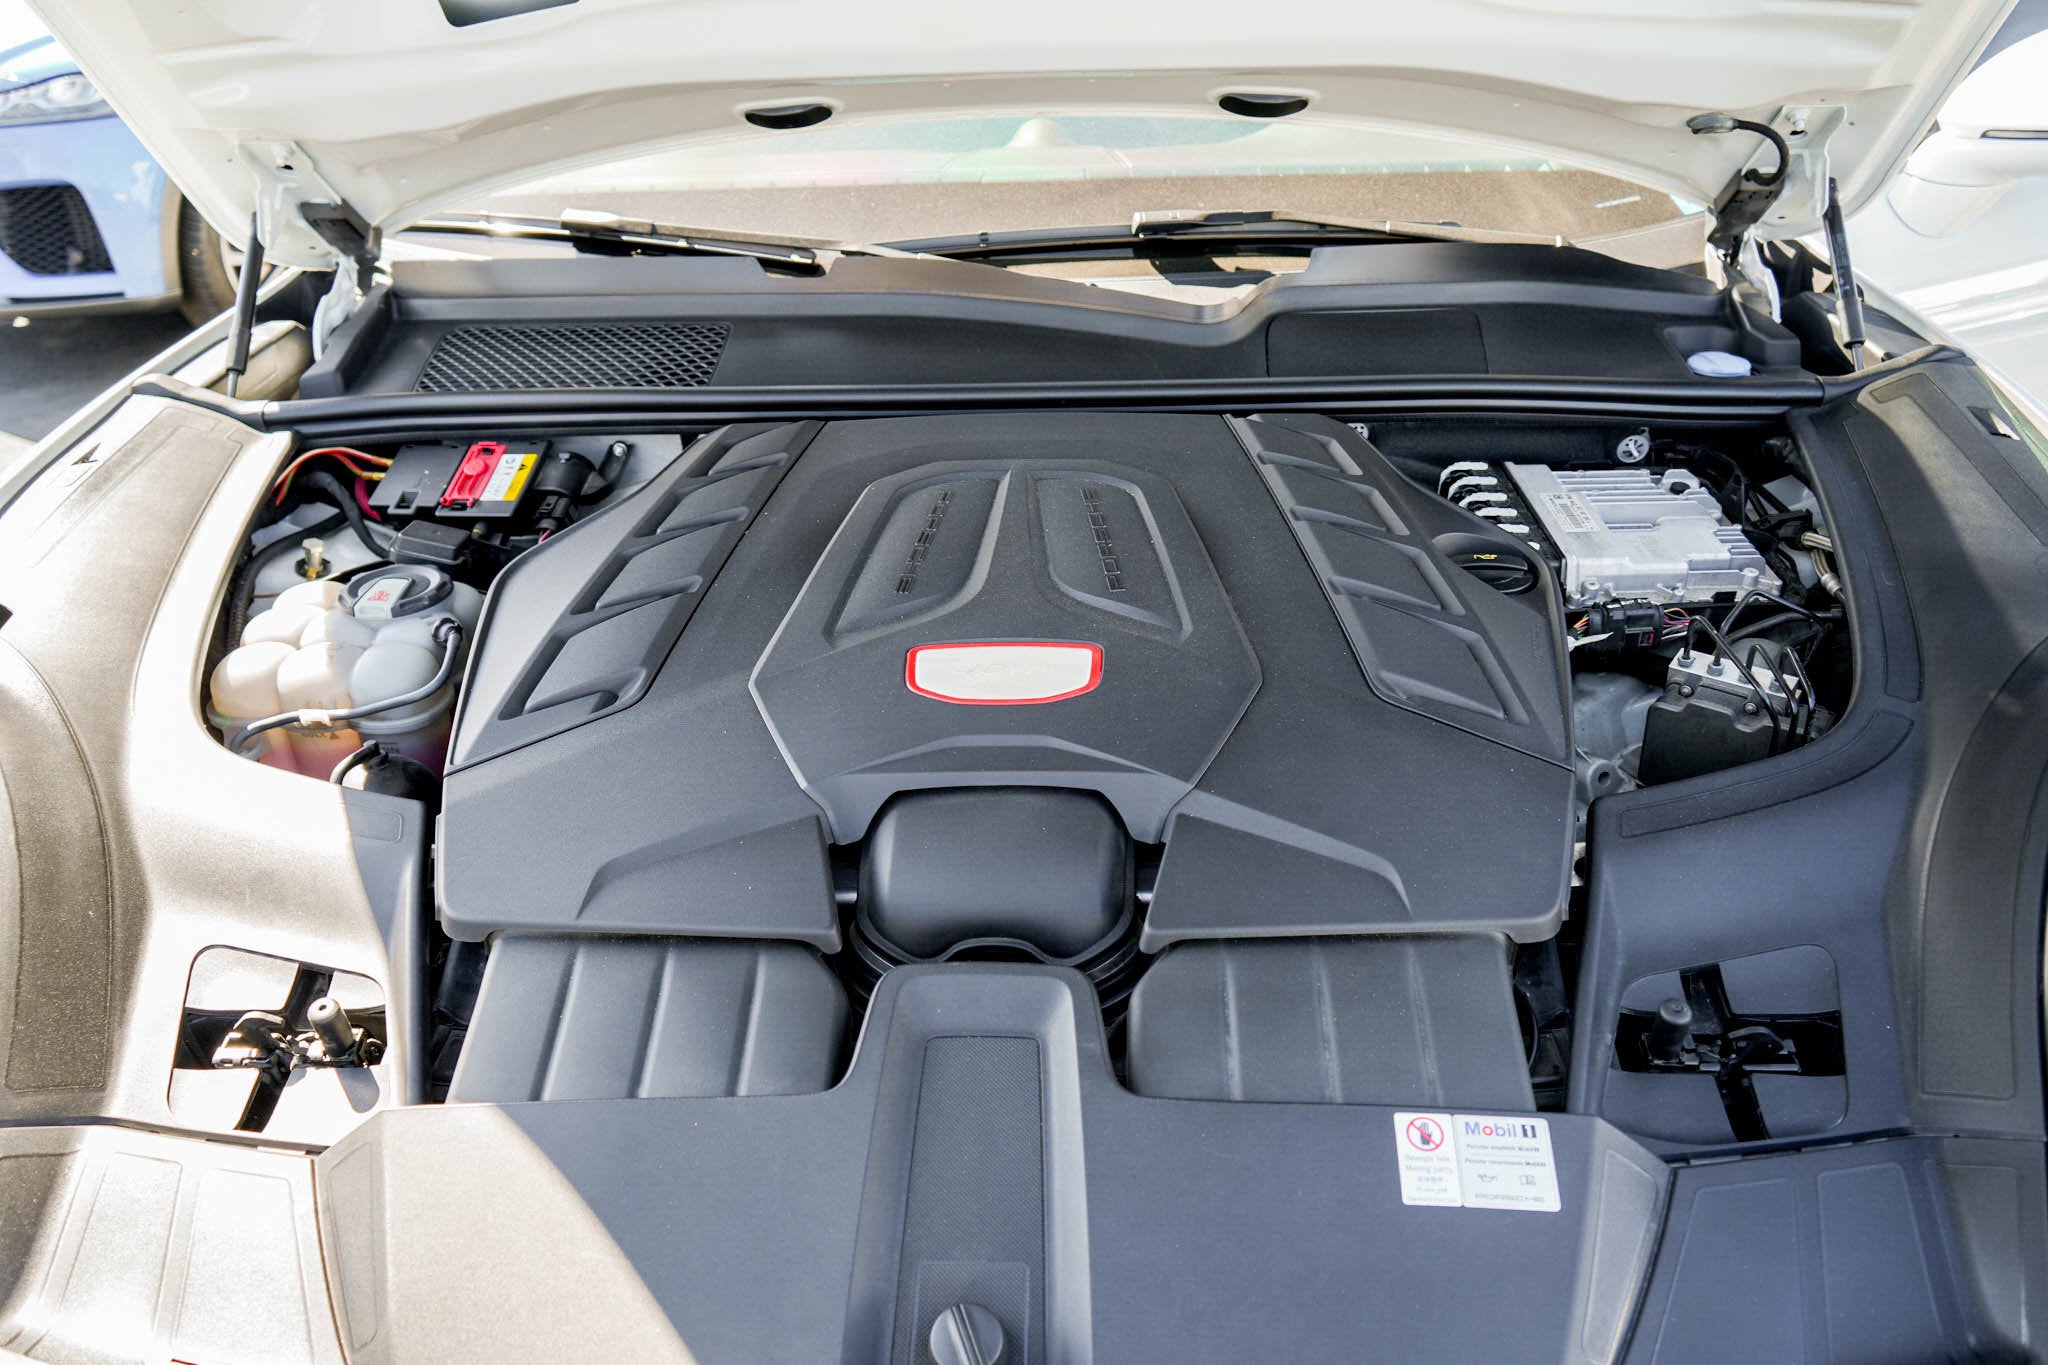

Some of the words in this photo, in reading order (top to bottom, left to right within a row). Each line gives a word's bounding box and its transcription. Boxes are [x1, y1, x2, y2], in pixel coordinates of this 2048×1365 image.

[895, 490, 952, 595] PORSCHE
[1080, 487, 1128, 592] PORSCHE
[1464, 1121, 1518, 1138] Mobil
